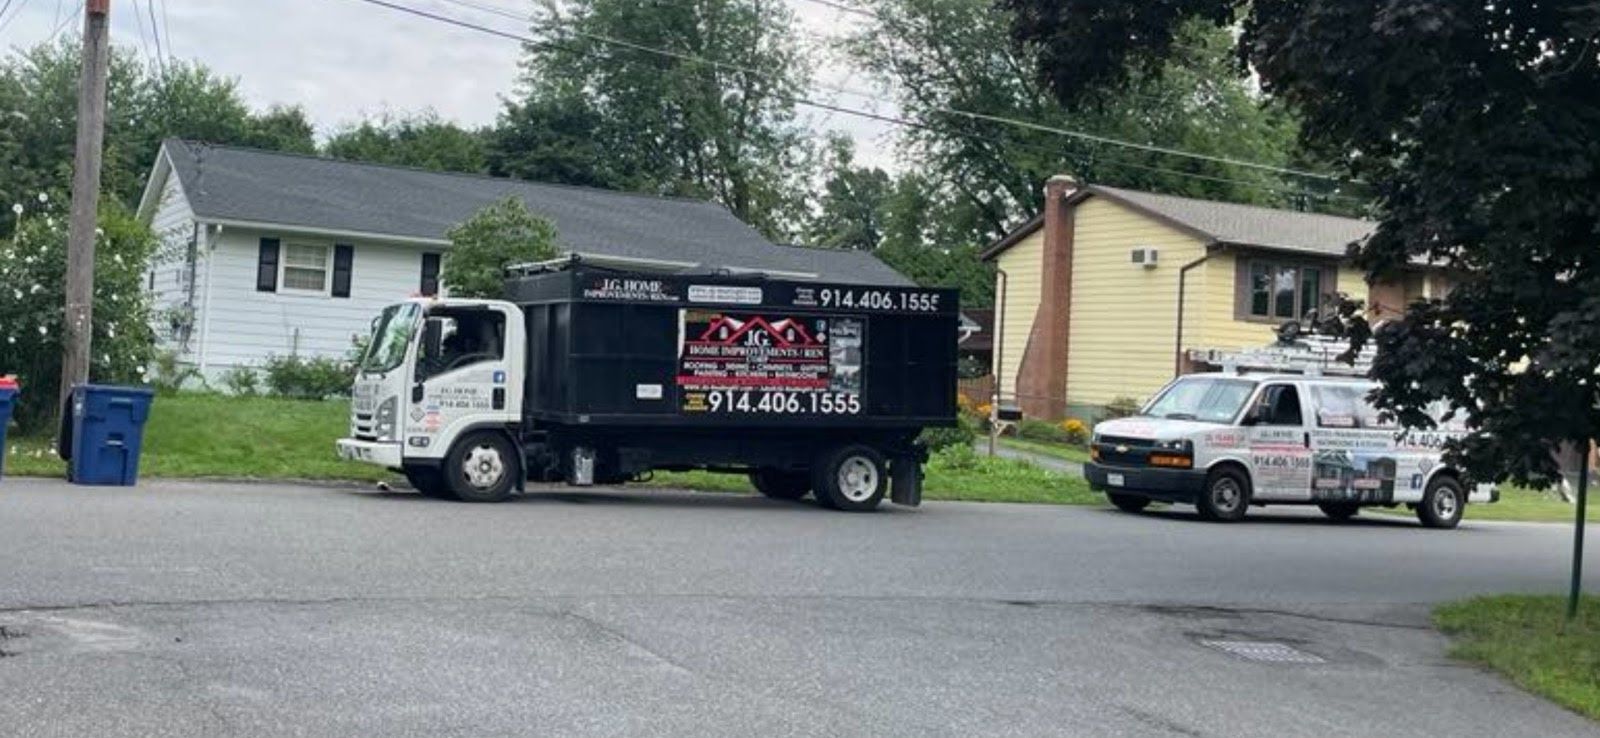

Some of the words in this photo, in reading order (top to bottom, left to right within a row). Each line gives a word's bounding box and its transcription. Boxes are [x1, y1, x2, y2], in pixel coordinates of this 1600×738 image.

[624, 279, 662, 292] HOME
[820, 289, 940, 311] 914.406.1555
[745, 329, 771, 347] J.G.
[690, 345, 720, 355] HOME
[721, 346, 799, 357] IMPROVEMENTS
[683, 361, 718, 369] ROOFING
[725, 362, 749, 371] SIDING
[694, 369, 728, 377] PAINTING
[708, 390, 861, 414] 914.406.1555
